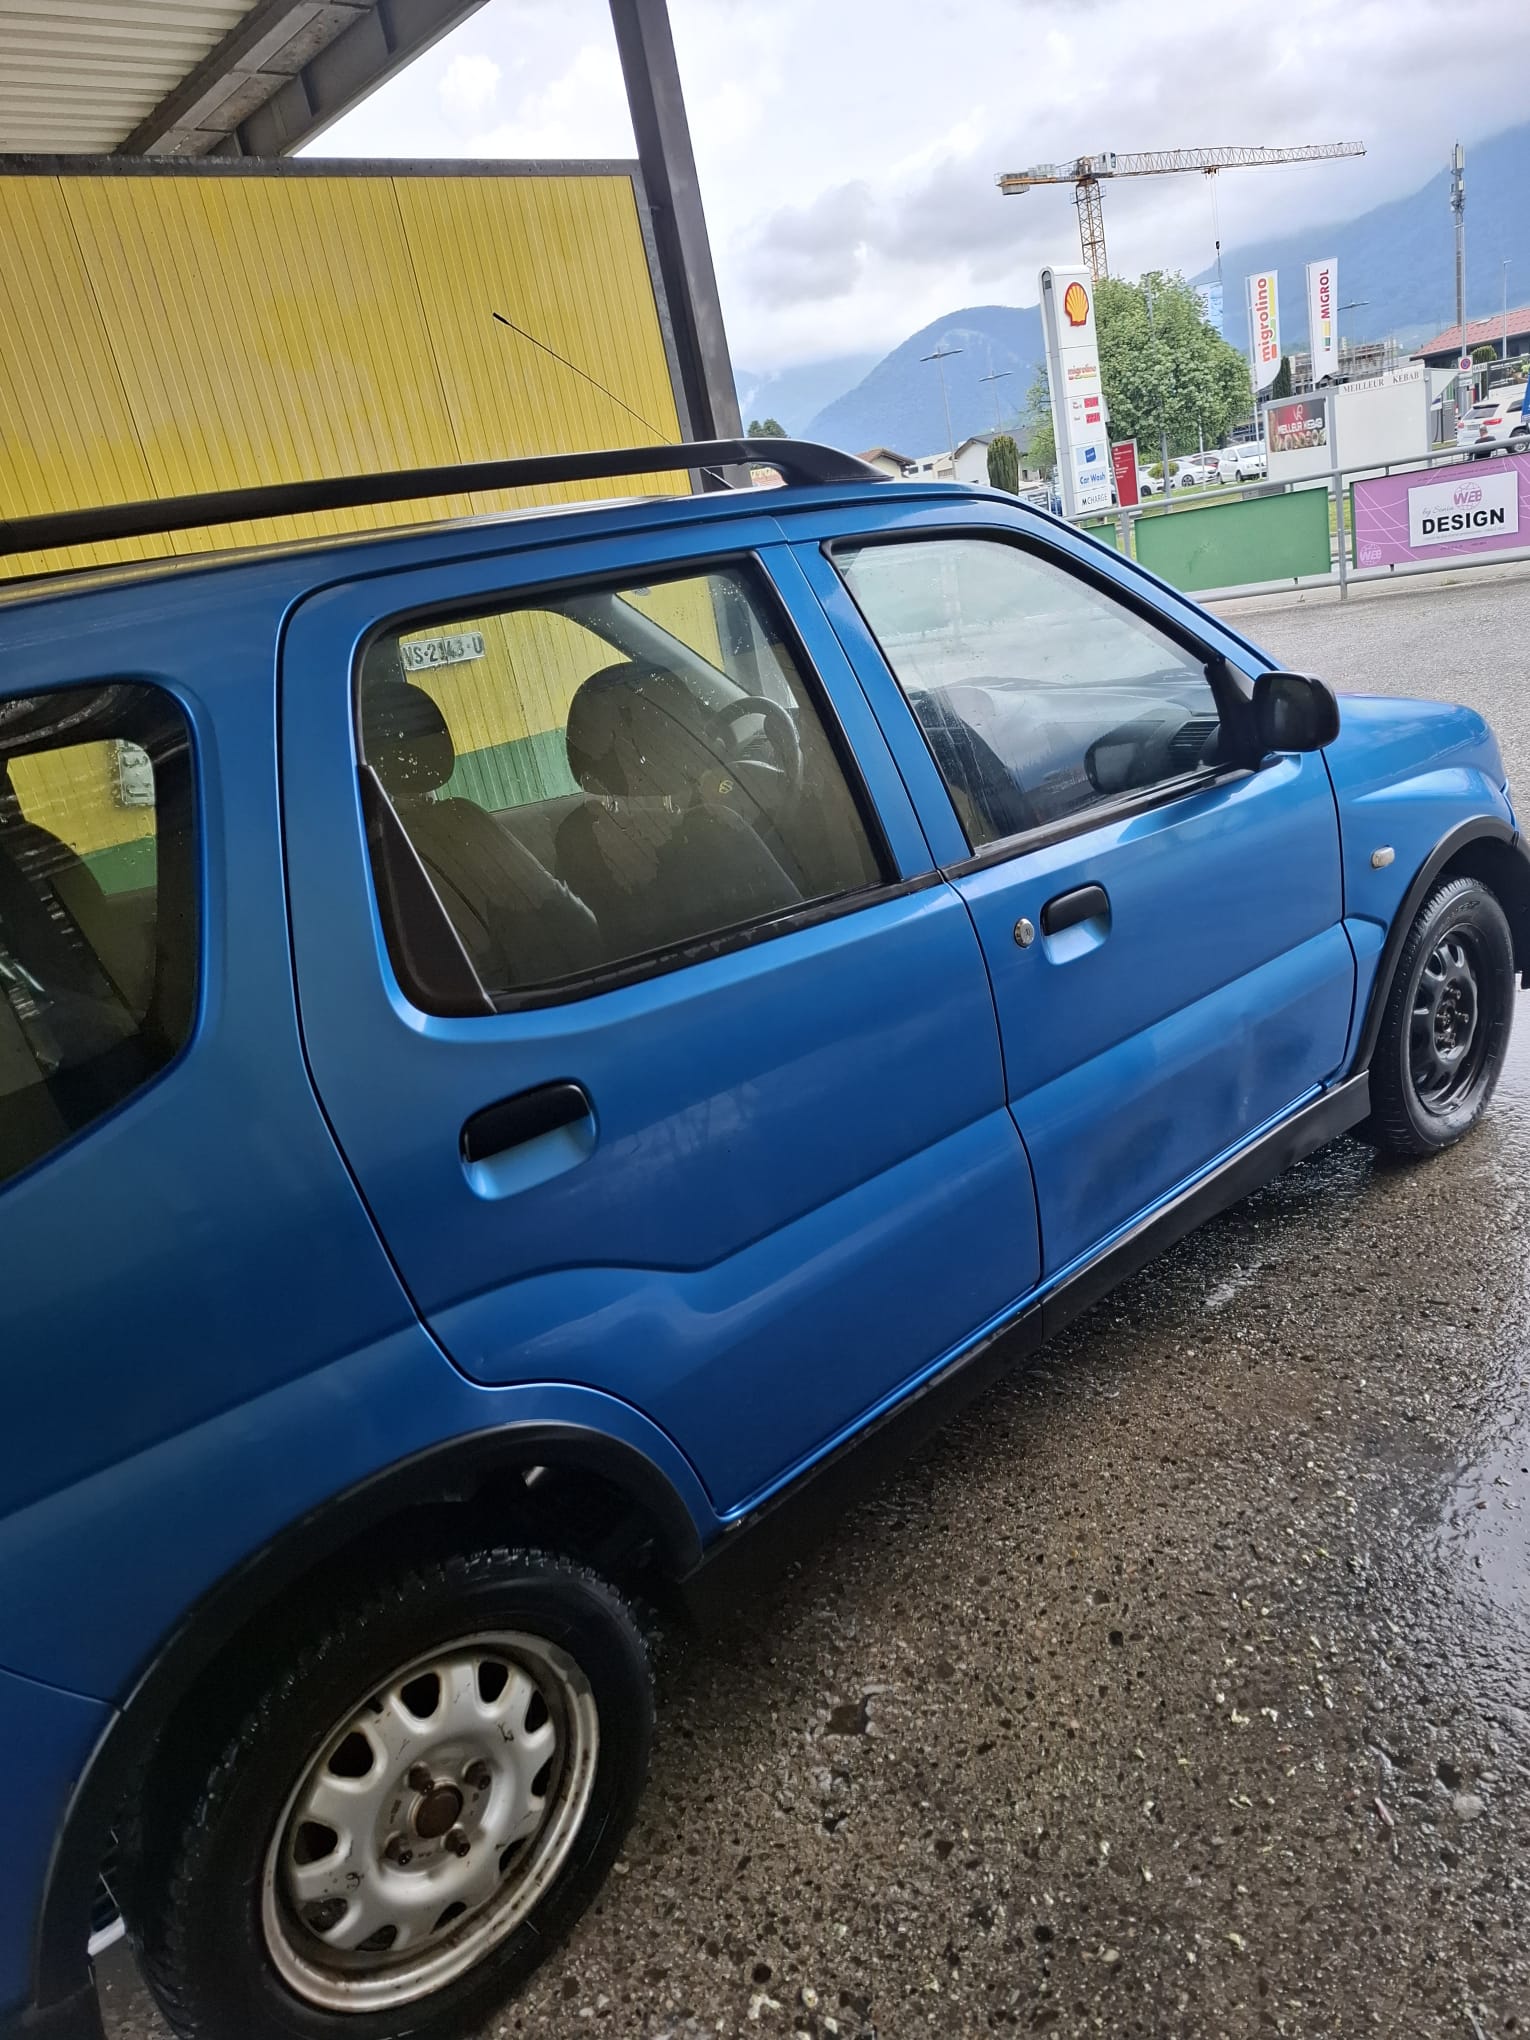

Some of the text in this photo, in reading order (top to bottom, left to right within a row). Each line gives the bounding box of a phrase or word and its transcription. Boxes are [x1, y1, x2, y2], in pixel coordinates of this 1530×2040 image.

[1320, 268, 1331, 319] MIGROL
[1255, 277, 1274, 363] migrolino
[1343, 372, 1420, 393] MEILLEUR KEBAB
[1080, 476, 1090, 485] Car
[1091, 472, 1106, 482] Wash
[1453, 489, 1483, 505] WEB
[1422, 507, 1505, 535] DESIGN
